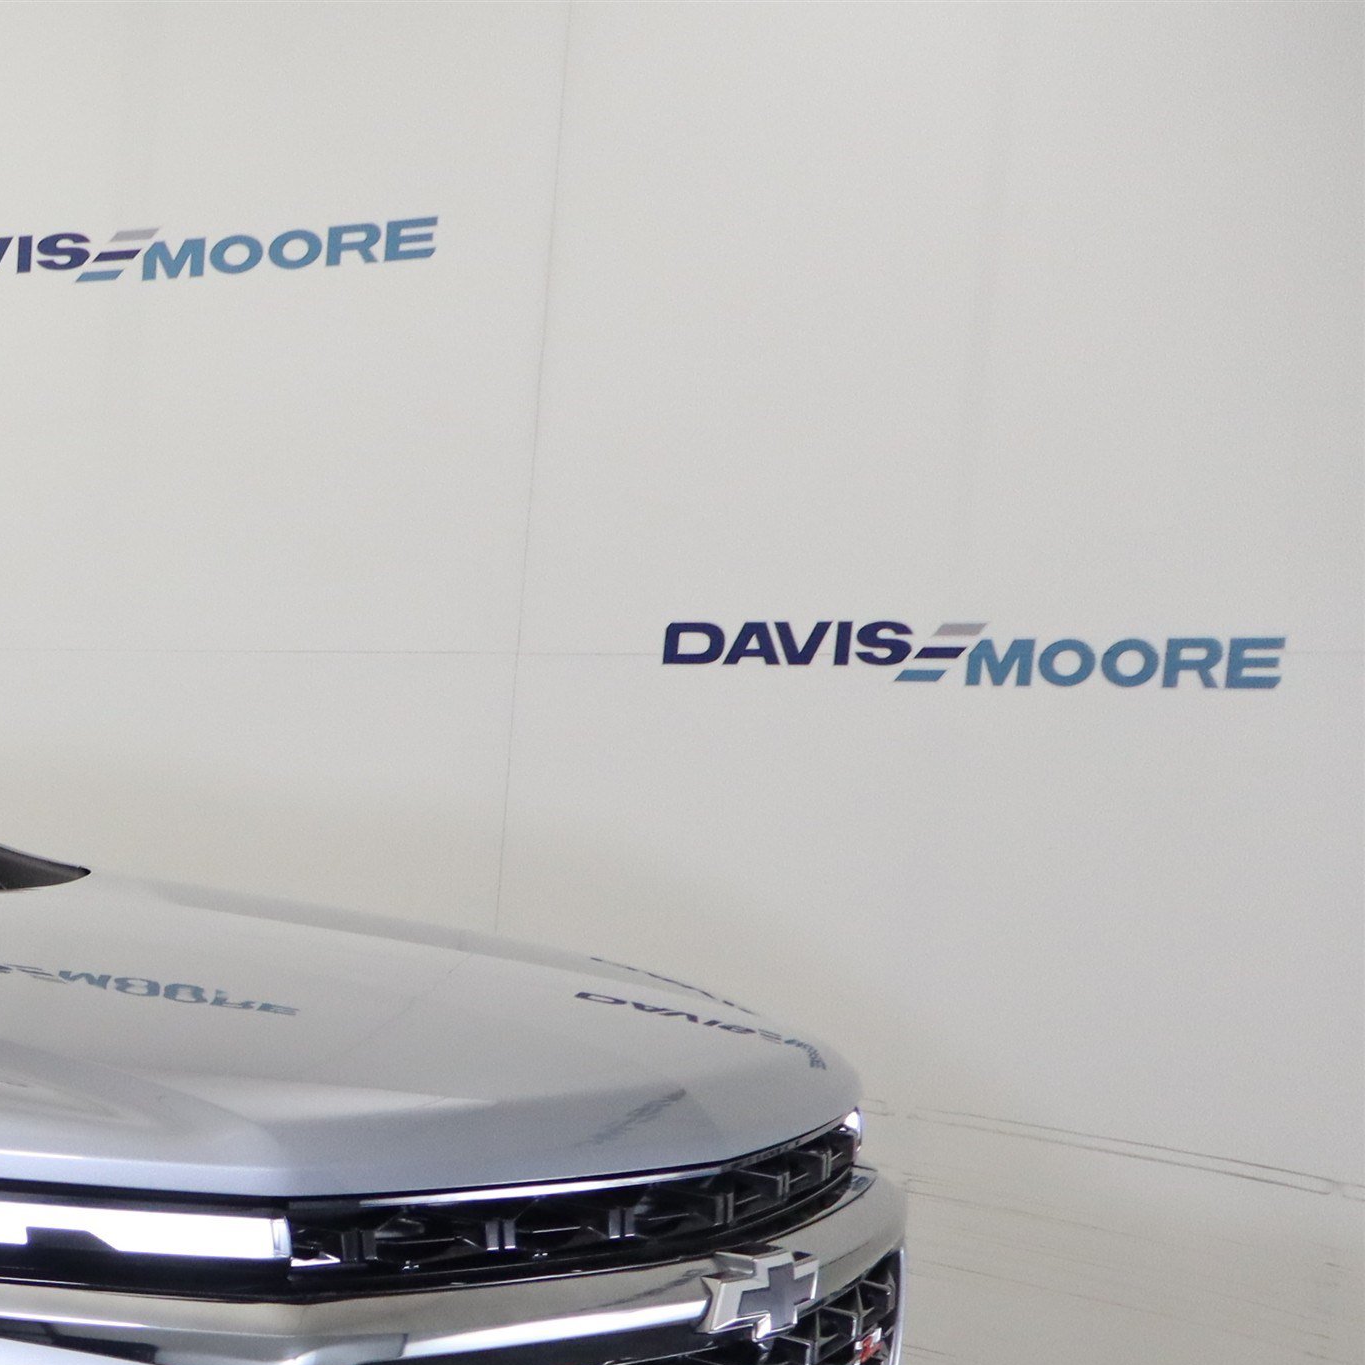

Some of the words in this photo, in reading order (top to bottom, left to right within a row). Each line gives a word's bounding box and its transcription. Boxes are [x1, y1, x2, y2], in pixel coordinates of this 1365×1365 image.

[141, 216, 439, 281] MOORE
[661, 620, 914, 666] DAVIS
[965, 636, 1287, 689] MOORE
